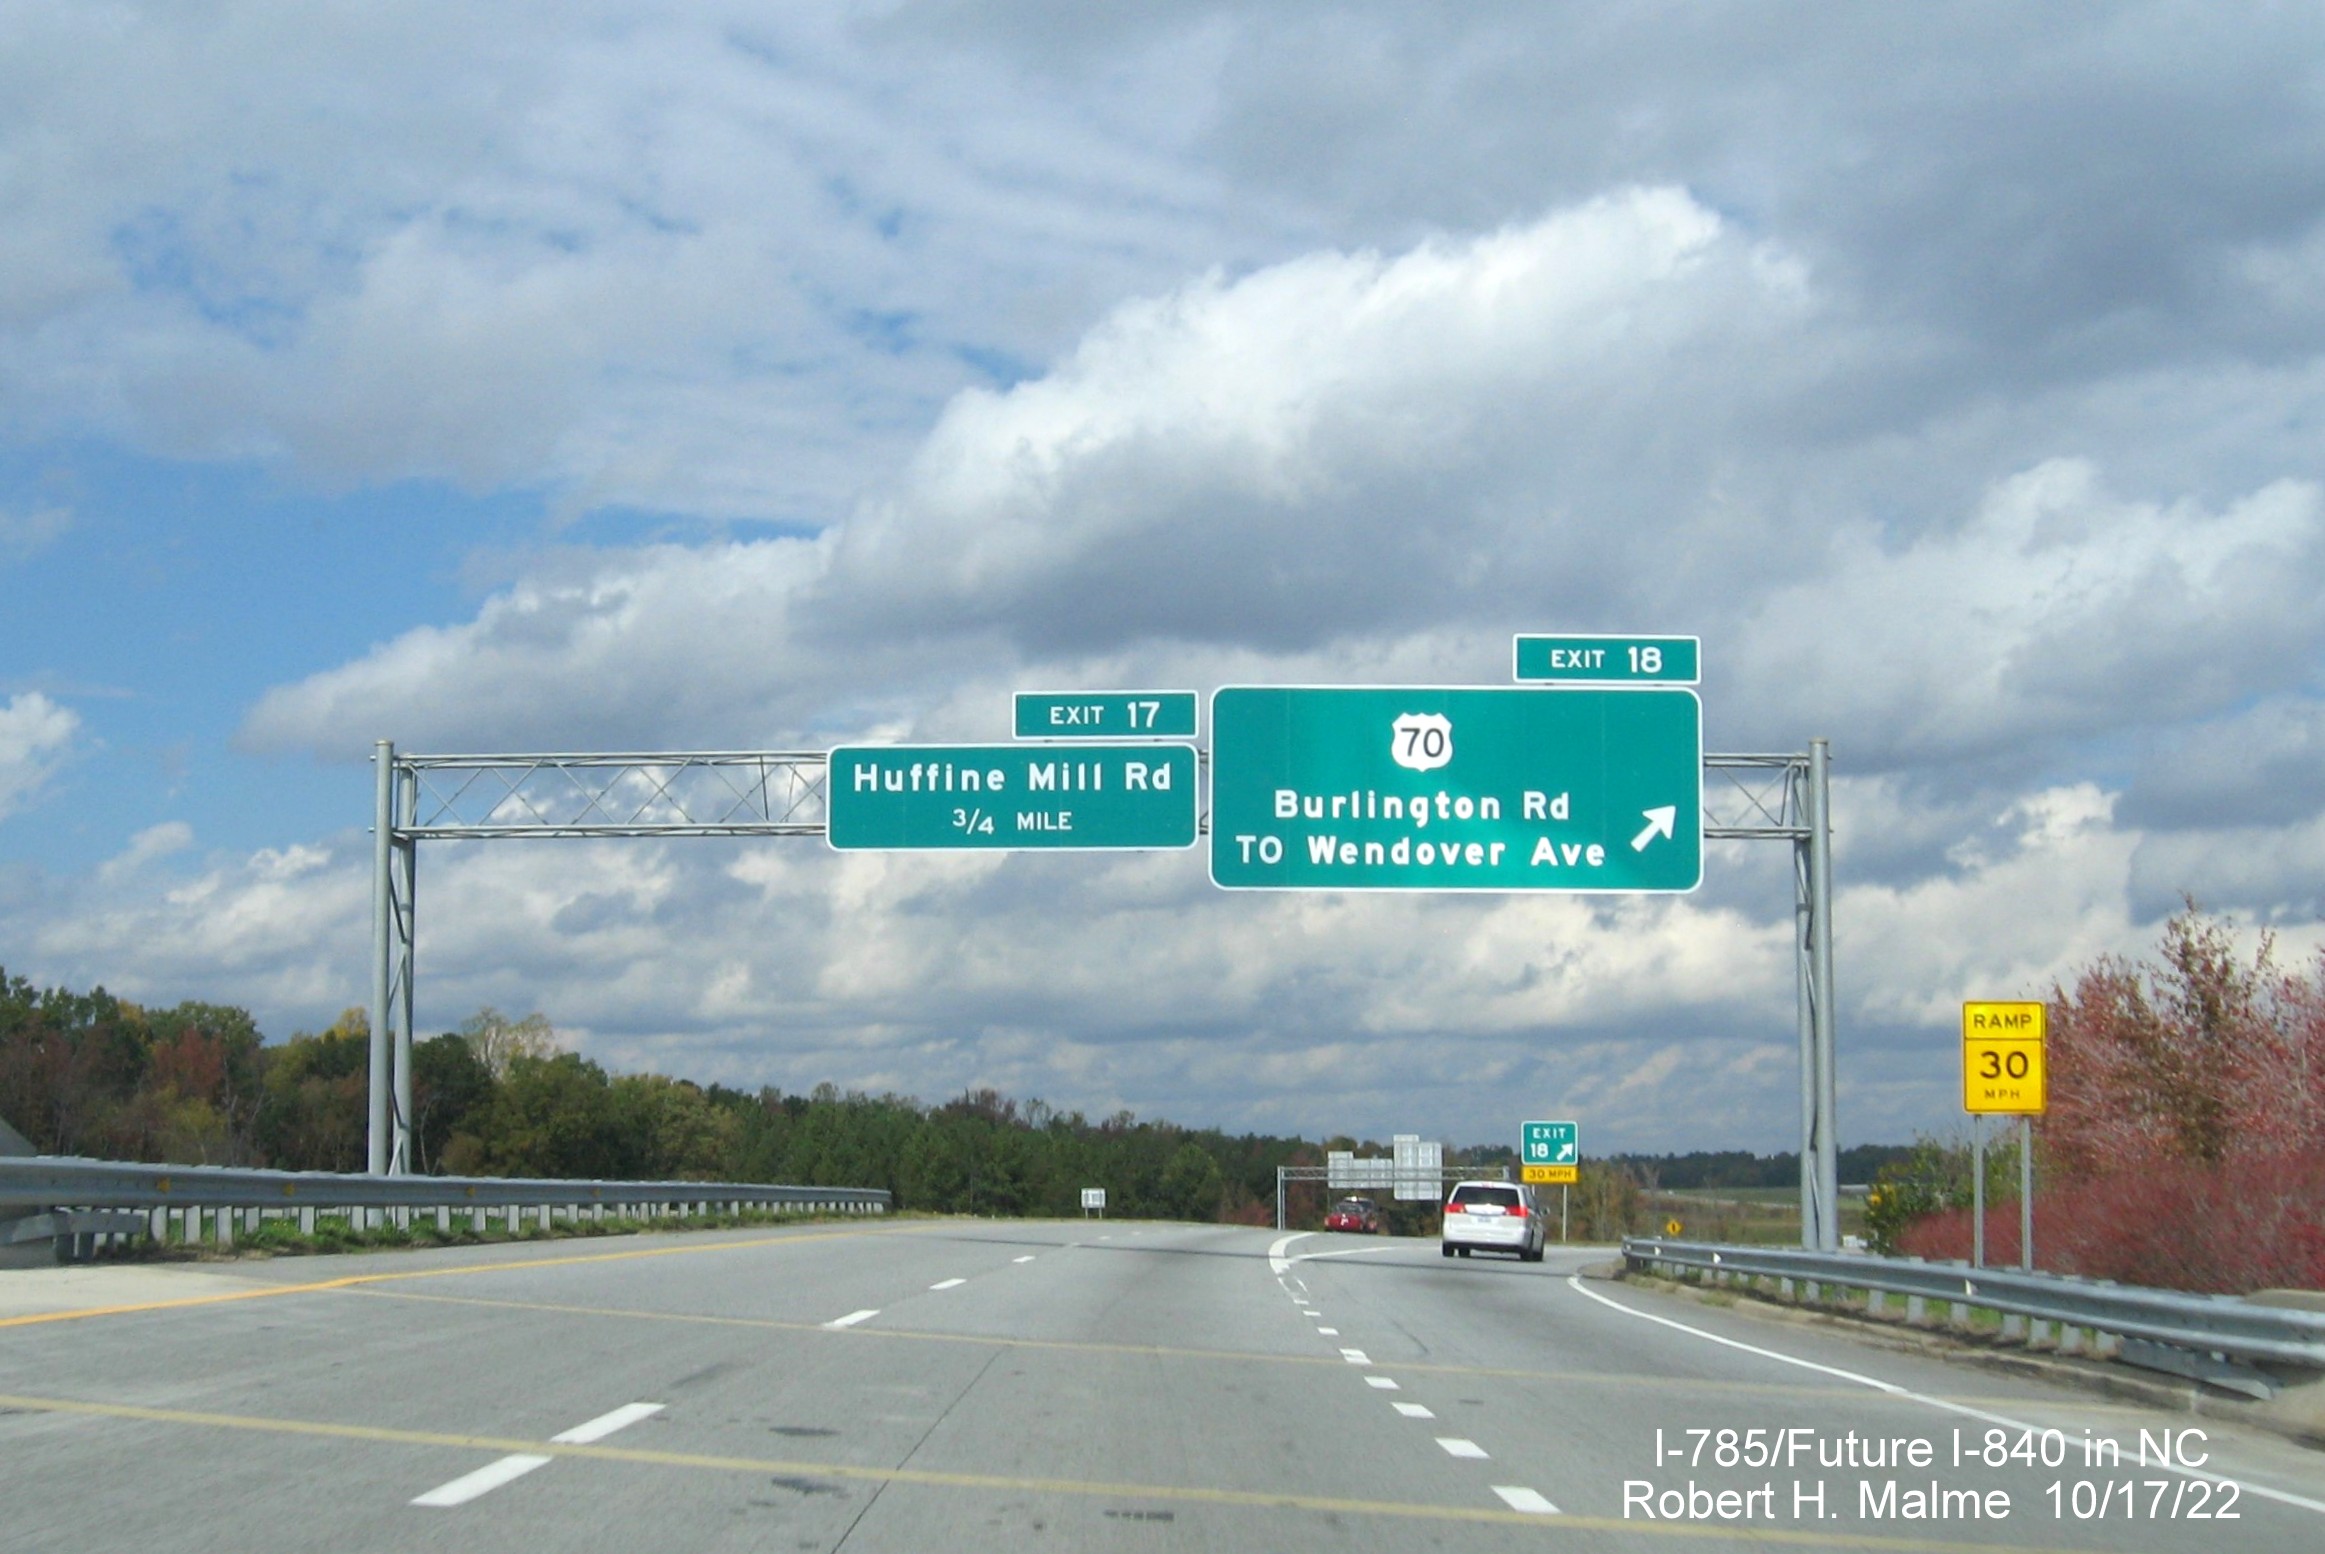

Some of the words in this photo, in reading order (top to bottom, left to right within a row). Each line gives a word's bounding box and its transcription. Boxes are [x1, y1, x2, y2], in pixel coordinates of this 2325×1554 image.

[1550, 649, 1606, 668] EXIT
[1627, 646, 1662, 673] 18
[1049, 706, 1104, 725] EXIT
[1127, 702, 1160, 728] 17
[1401, 727, 1445, 759] 70
[854, 762, 1005, 792] Huffine
[1028, 762, 1104, 791] Mill
[1125, 762, 1172, 791] Rd
[1274, 790, 1500, 827] Burlington
[1523, 792, 1570, 821] Rd
[952, 809, 995, 835] 3/4
[1016, 812, 1073, 831] MILE
[1236, 836, 1283, 864] TO
[1307, 836, 1506, 866] Wendover
[1530, 838, 1605, 866] Ave
[1973, 1013, 2032, 1029] RAMP
[1979, 1050, 2029, 1079] 30
[1984, 1089, 2020, 1099] MPH
[1532, 1127, 1566, 1139] EXIT
[1530, 1142, 1549, 1158] 18
[1529, 1169, 1545, 1179] 30
[1549, 1168, 1572, 1179] MPH
